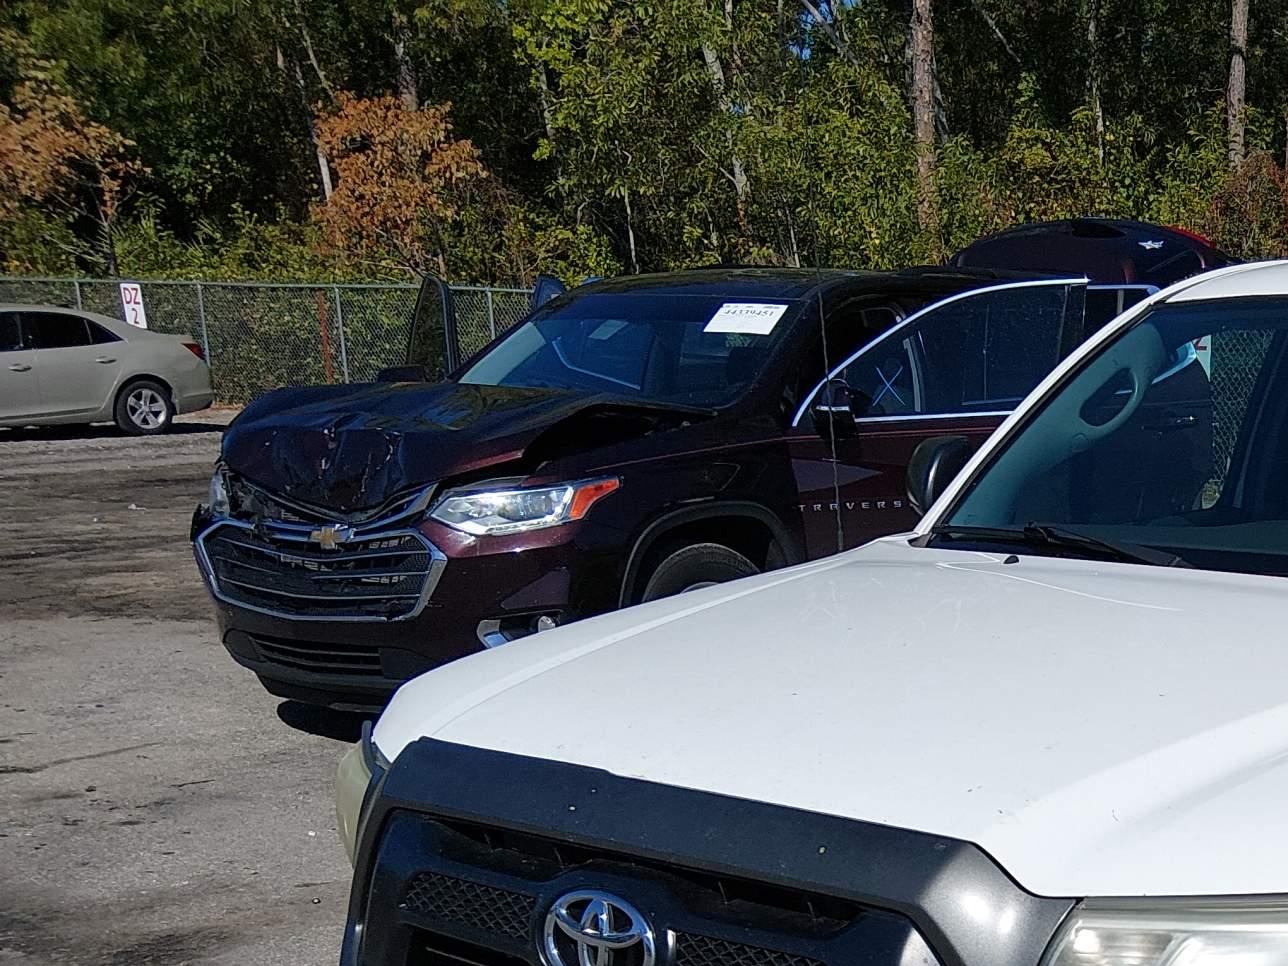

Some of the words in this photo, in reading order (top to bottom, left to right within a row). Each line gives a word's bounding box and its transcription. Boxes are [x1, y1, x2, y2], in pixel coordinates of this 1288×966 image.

[123, 287, 141, 305] DZ
[131, 307, 140, 325] 2
[798, 500, 902, 512] TRAVERS
